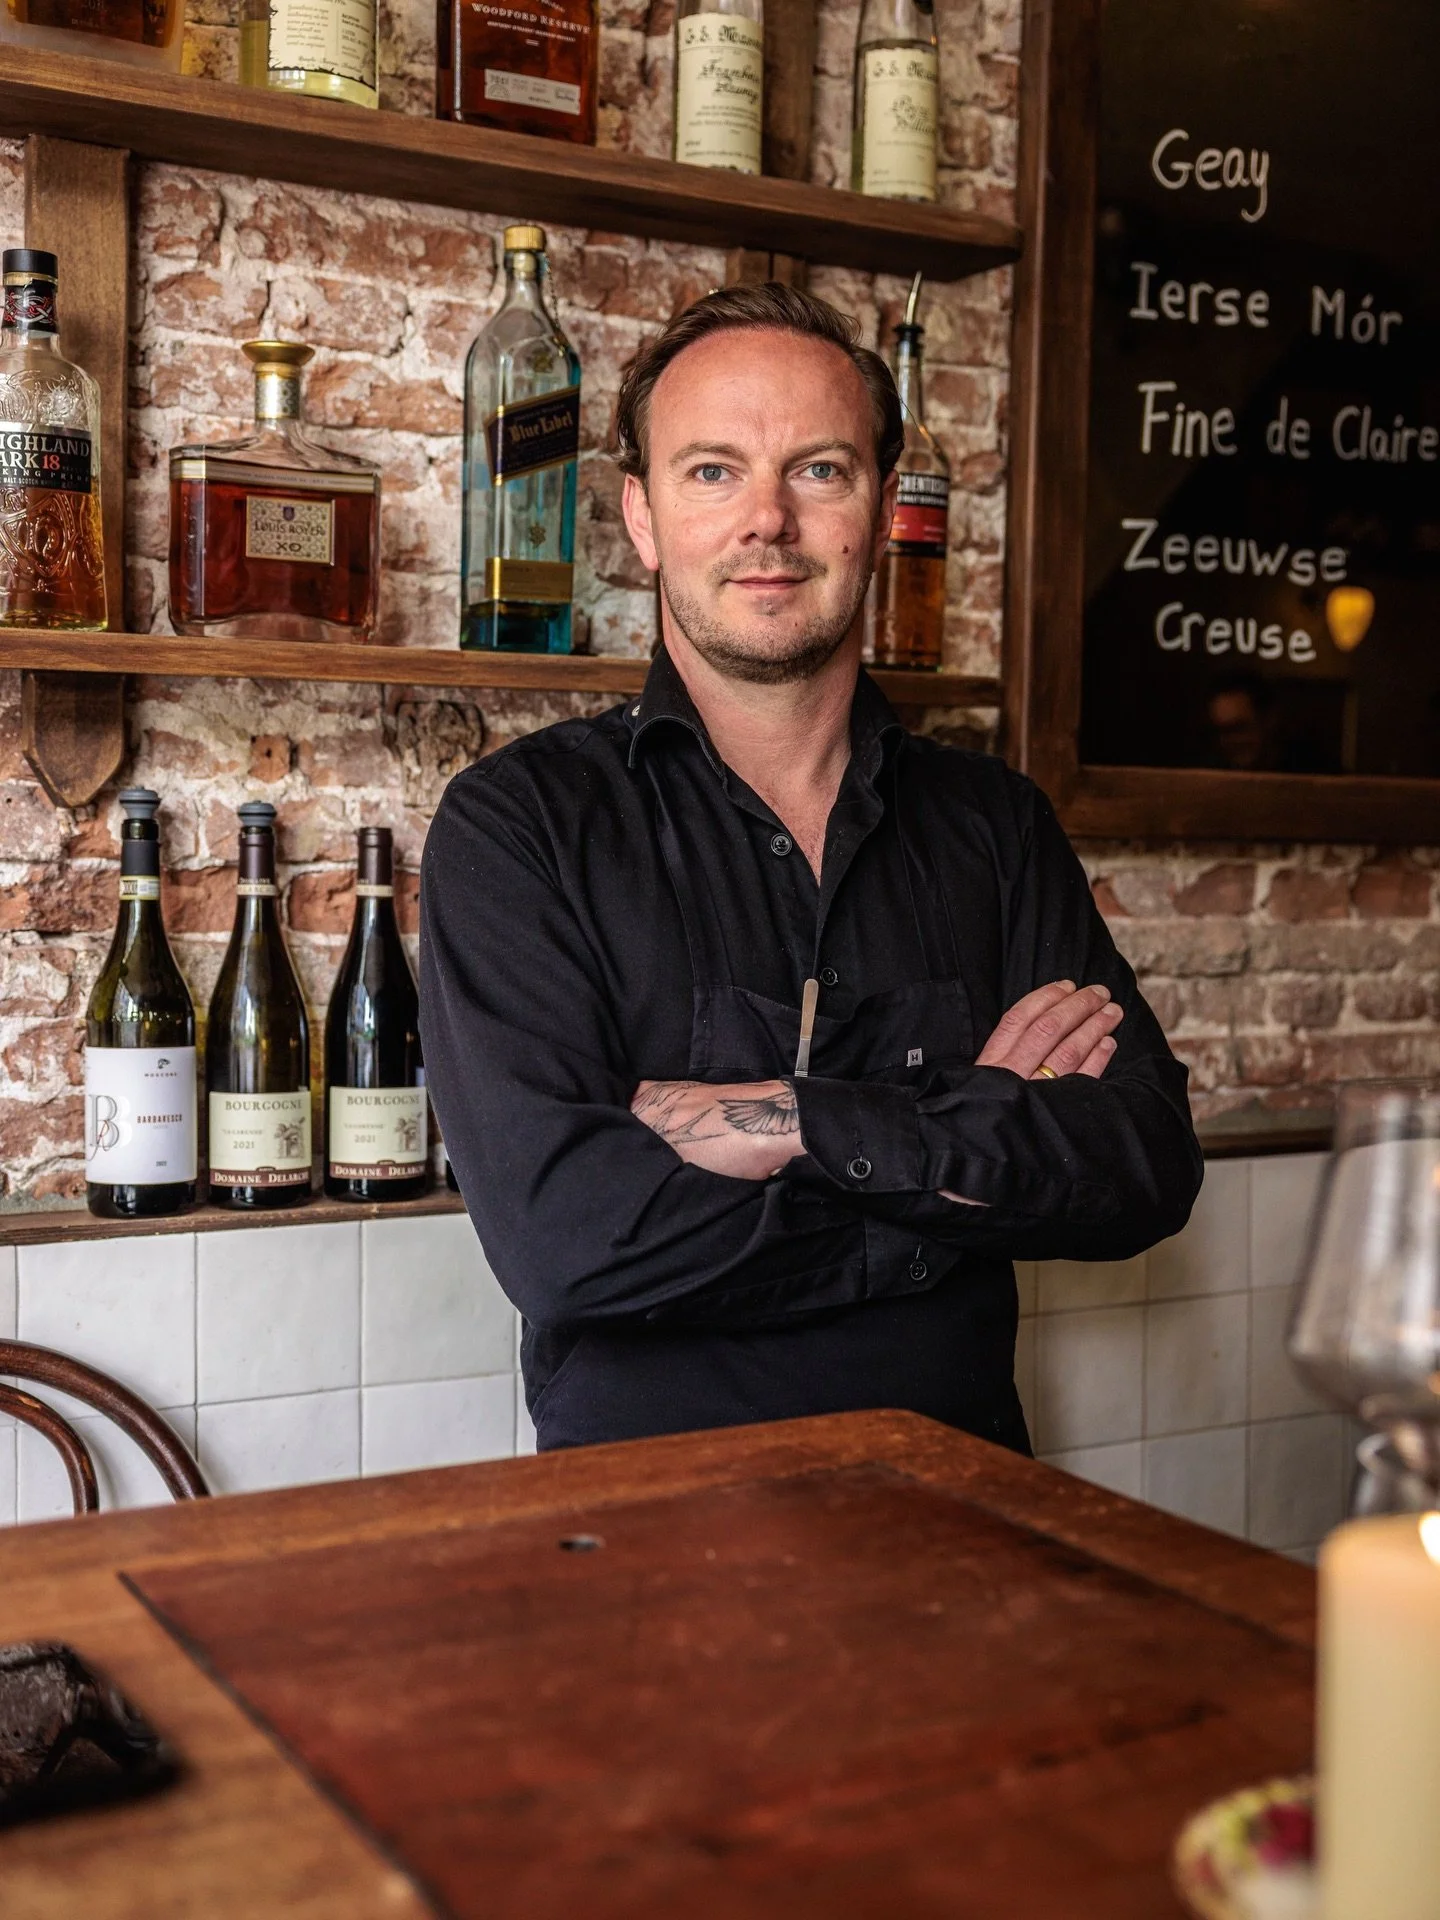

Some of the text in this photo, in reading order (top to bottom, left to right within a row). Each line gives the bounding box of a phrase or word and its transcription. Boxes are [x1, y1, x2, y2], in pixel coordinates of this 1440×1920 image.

[471, 2, 537, 23] WOODFORD
[540, 15, 591, 35] RESERVE
[1152, 128, 1269, 222] Geay
[1129, 261, 1403, 346] Ierse Mór
[1137, 381, 1440, 463] Fine de Claire
[0, 433, 90, 457] IGHLAND
[0, 451, 40, 470] ARK
[42, 454, 60, 471] 18
[277, 542, 302, 553] XO
[1121, 518, 1348, 586] Zeeuwse
[1155, 602, 1317, 663] Creuse
[233, 1140, 255, 1150] 2021
[214, 1172, 262, 1184] DOMAINE
[334, 1165, 382, 1177] DOMAINE
